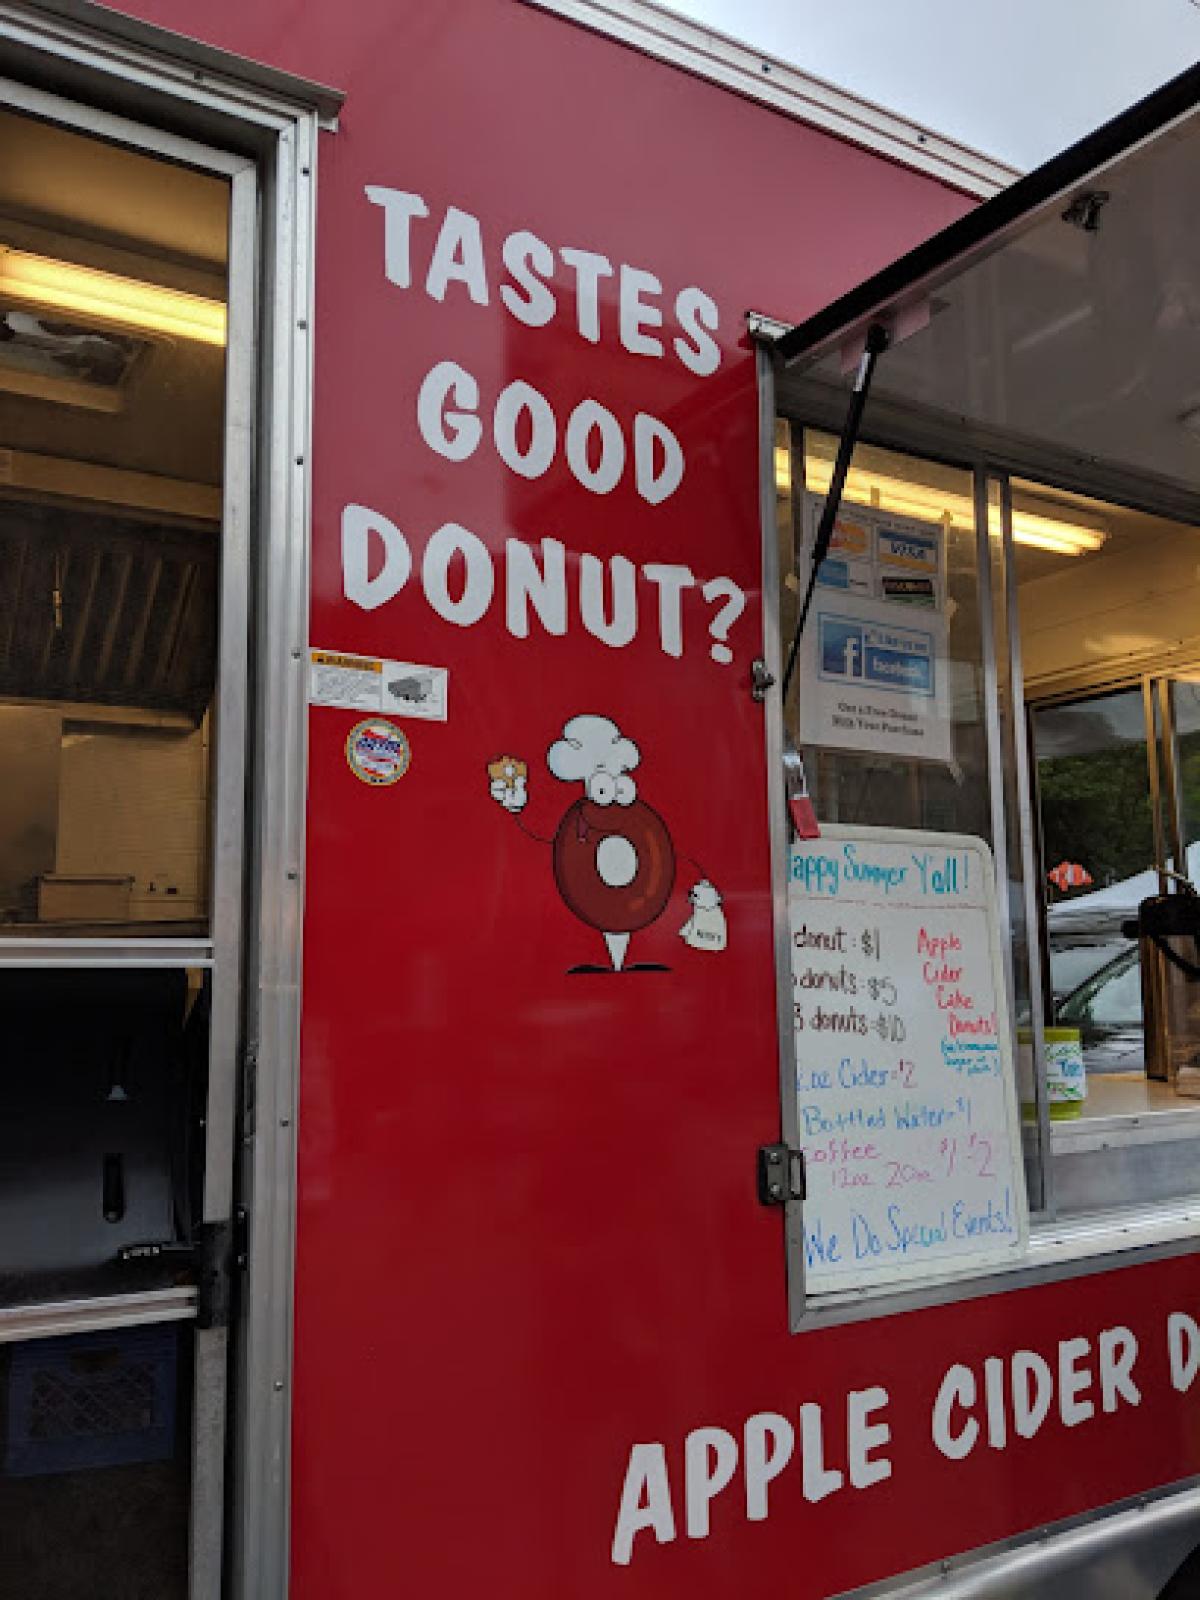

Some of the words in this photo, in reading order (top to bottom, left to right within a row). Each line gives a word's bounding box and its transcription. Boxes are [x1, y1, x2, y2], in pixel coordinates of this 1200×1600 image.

[365, 185, 721, 377] TASTES
[418, 361, 683, 504] GOOD
[341, 503, 745, 663] DONUT?
[789, 848, 839, 894] appy
[843, 843, 909, 894] Summer
[916, 926, 963, 960] Apple
[922, 962, 964, 984] Cider
[850, 1209, 883, 1260] Do
[611, 1386, 892, 1566] APPLE
[931, 1325, 1142, 1460] CIDER
